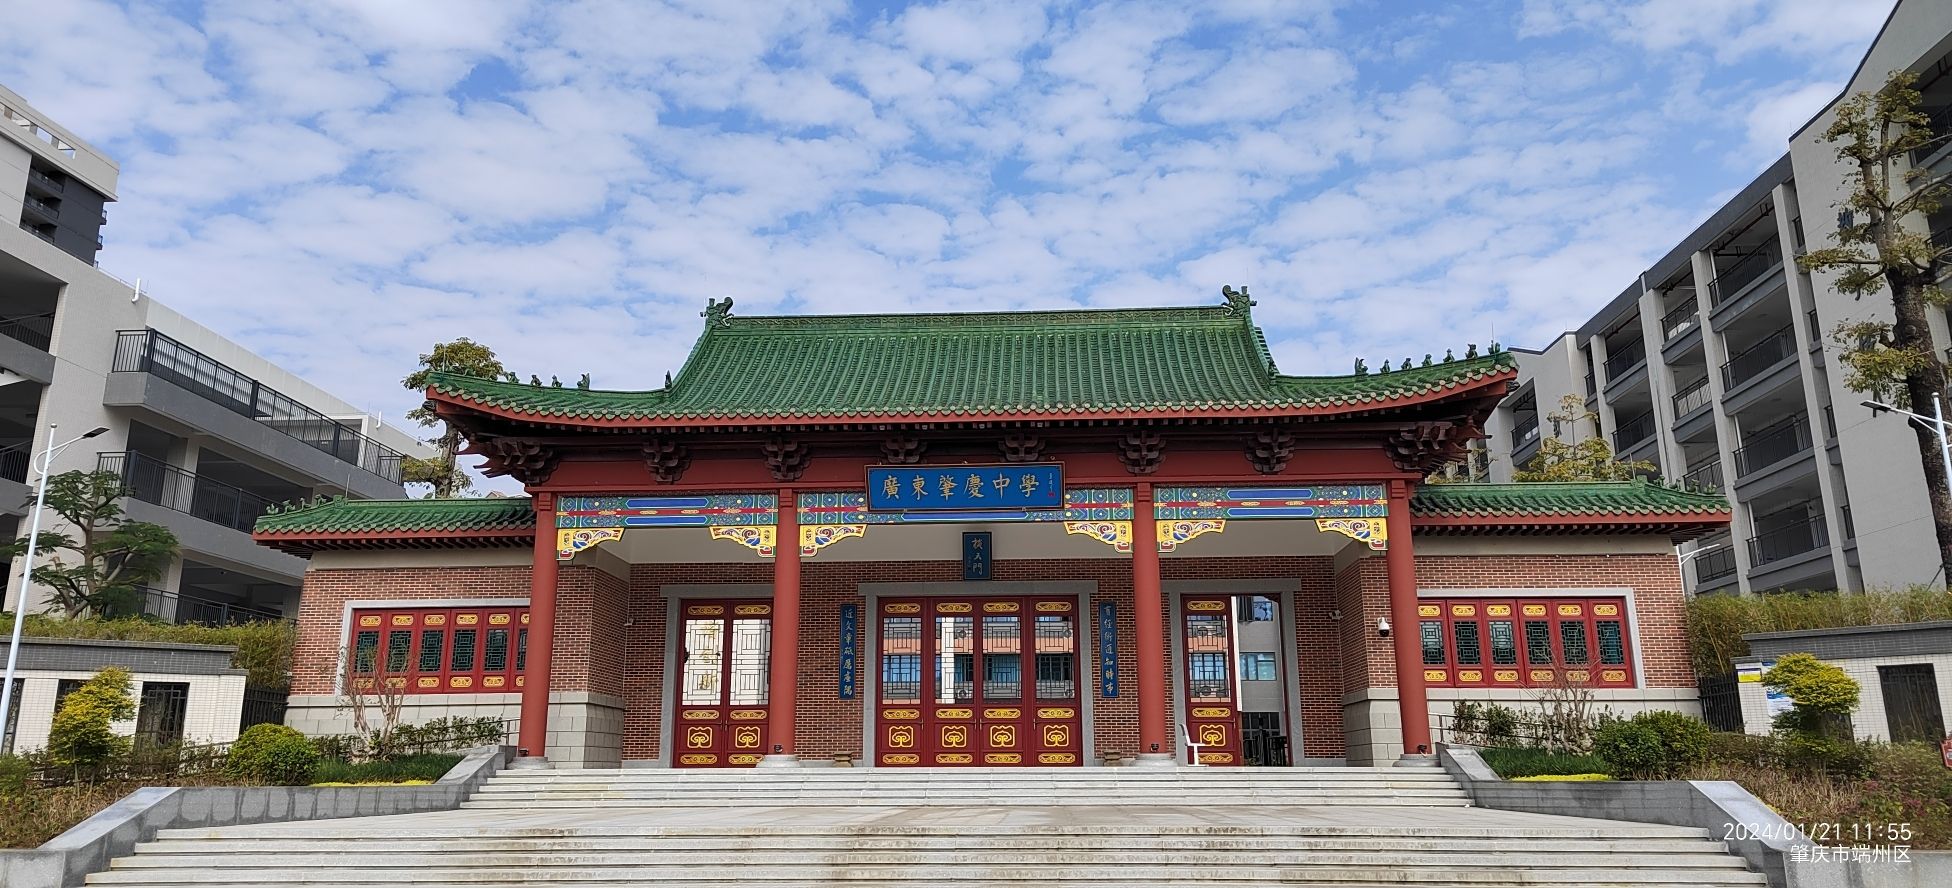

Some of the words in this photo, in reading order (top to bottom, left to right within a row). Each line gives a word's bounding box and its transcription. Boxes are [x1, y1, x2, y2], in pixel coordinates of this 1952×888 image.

[881, 473, 1040, 500] 廣東肇慶中學
